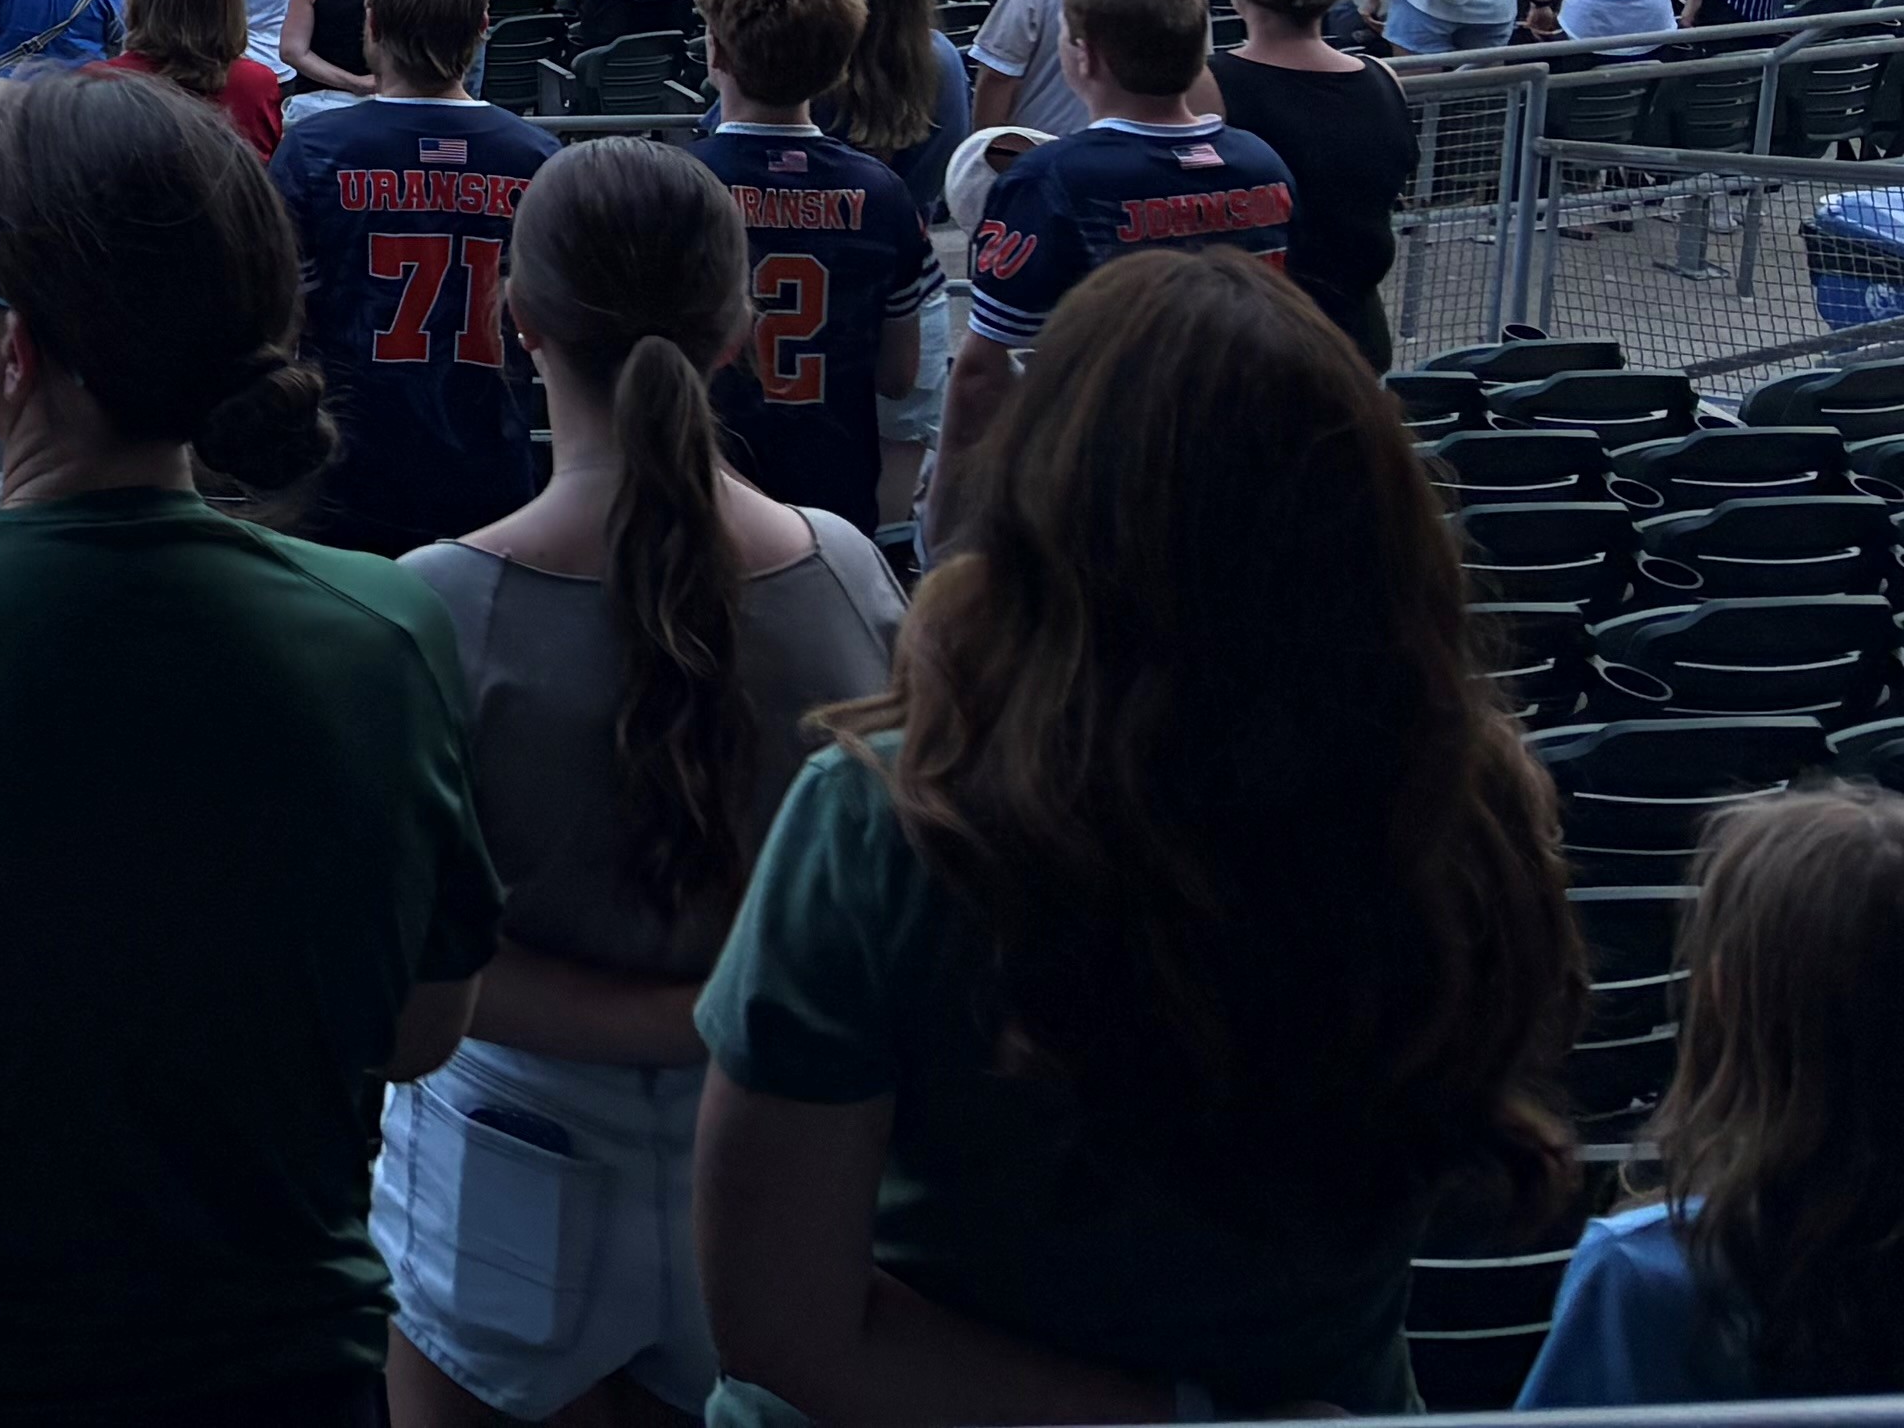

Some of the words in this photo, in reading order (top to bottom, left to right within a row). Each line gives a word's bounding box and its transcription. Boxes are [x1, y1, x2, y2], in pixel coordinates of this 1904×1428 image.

[1116, 182, 1292, 243] JOHNSON
[368, 233, 503, 367] 71
[753, 254, 829, 404] 2
